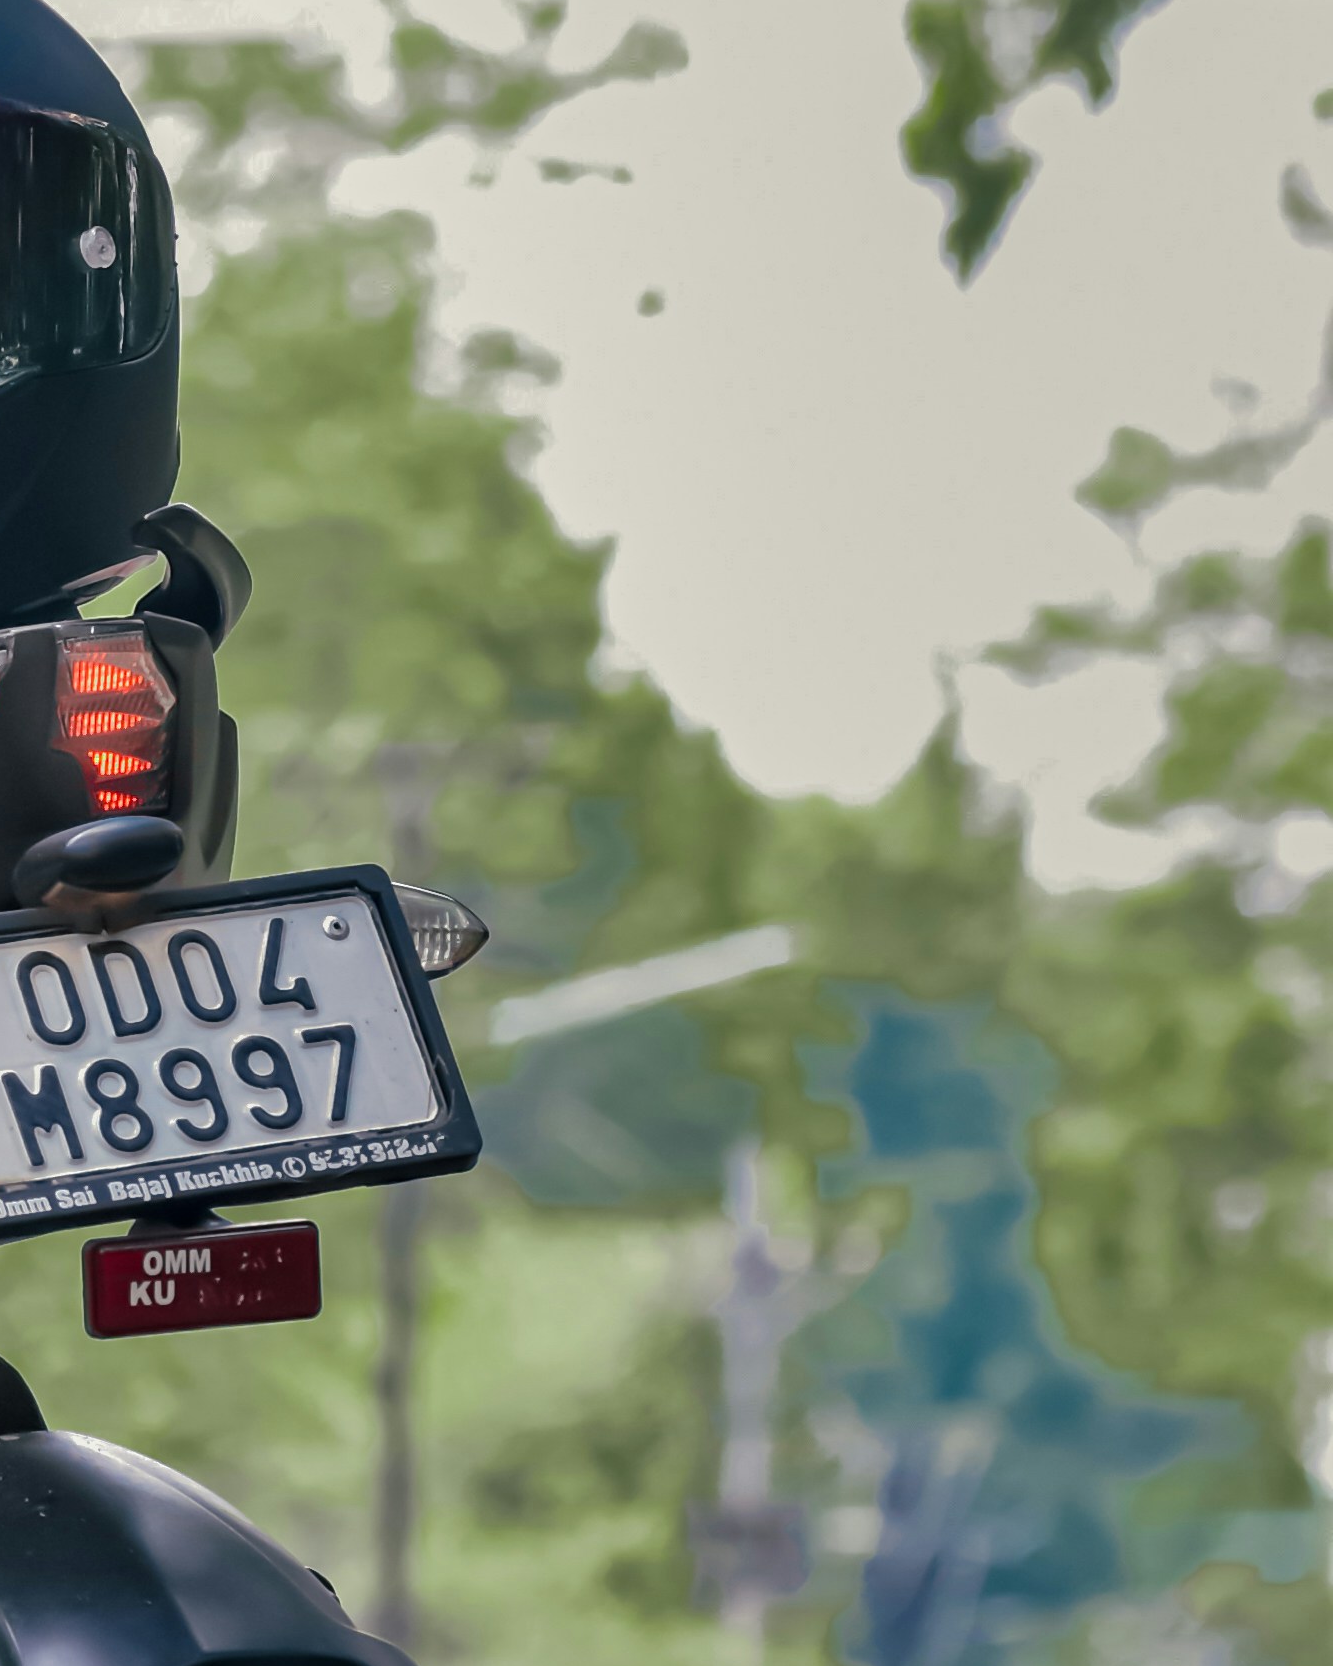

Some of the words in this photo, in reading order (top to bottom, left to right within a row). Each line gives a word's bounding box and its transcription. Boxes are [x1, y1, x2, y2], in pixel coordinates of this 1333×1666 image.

[16, 918, 316, 1045] OD04
[1, 1025, 356, 1166] M8997
[55, 1185, 96, 1209] Sai
[108, 1174, 173, 1202] Bajaj
[143, 1248, 211, 1276] OMM
